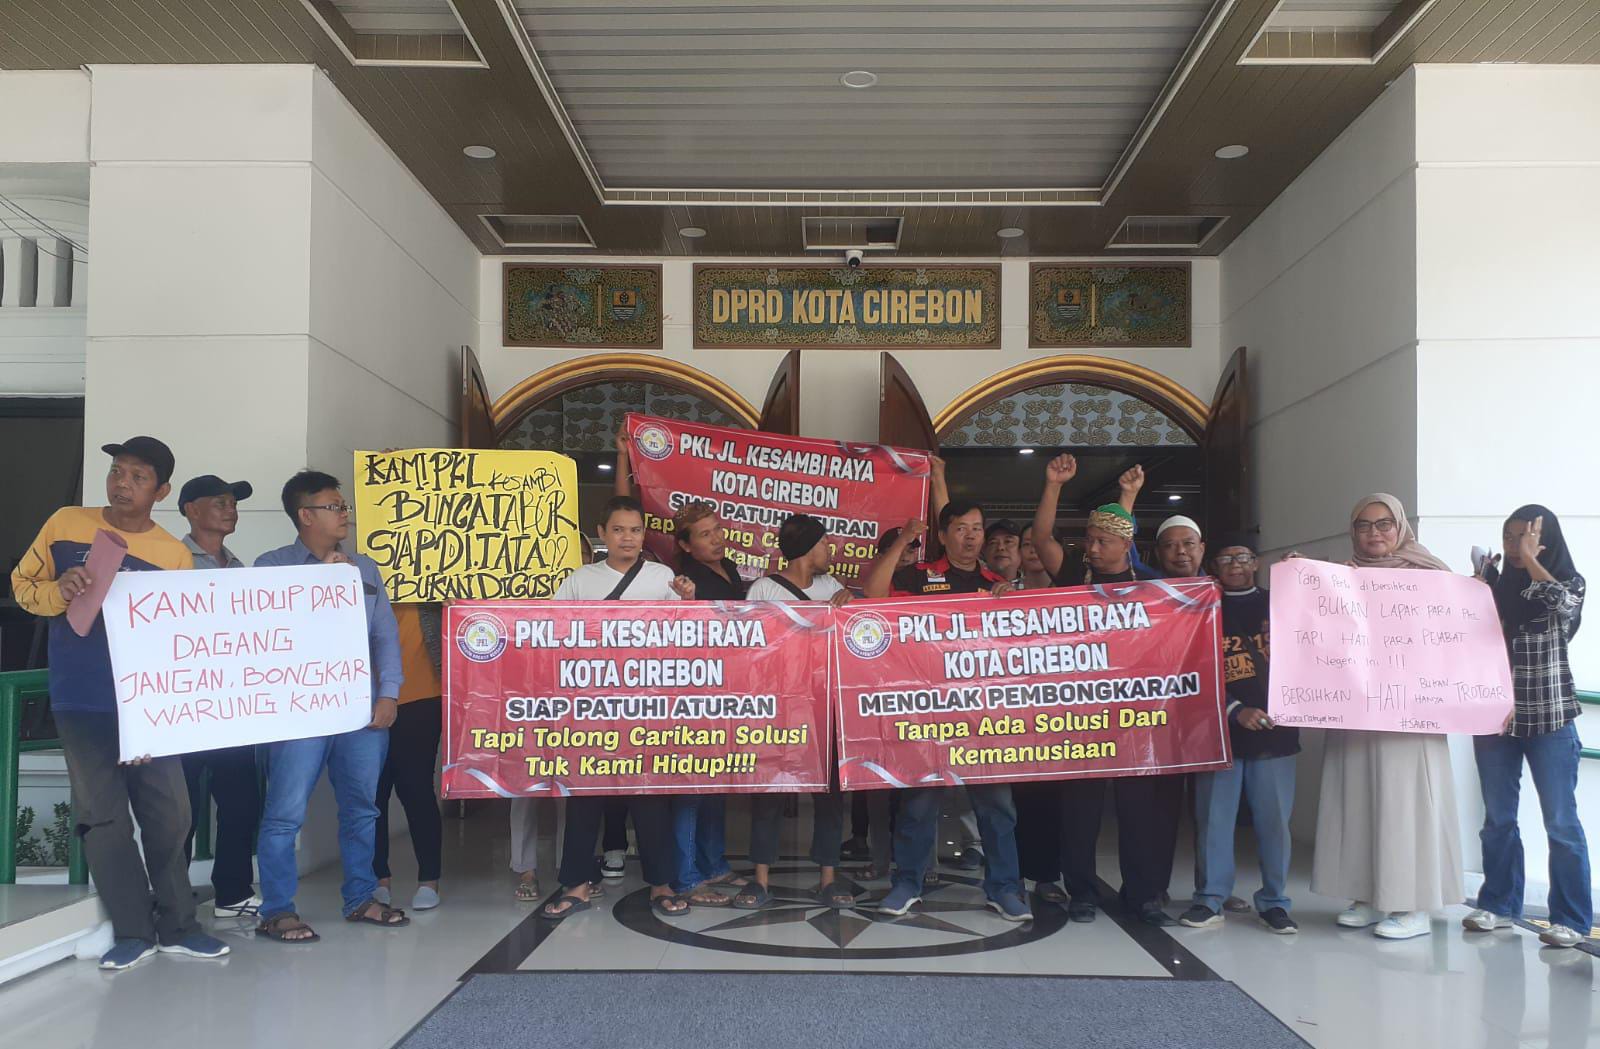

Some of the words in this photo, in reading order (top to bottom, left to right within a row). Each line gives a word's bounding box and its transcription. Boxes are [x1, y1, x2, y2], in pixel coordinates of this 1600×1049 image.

[712, 289, 783, 324] DPRD
[792, 289, 856, 324] KOTA
[863, 289, 982, 324] CIREBON
[428, 450, 485, 491] PKL
[679, 433, 714, 460] PKL
[716, 440, 742, 465] JL.
[746, 444, 826, 476] KESAMBI
[830, 455, 874, 483] RAYA
[711, 470, 757, 498] KOTA
[760, 478, 839, 510] CIREBON
[644, 513, 675, 534] Tap
[808, 515, 878, 539] URAN
[384, 573, 475, 600] BUKAN
[1294, 566, 1320, 590] Yang
[231, 584, 304, 615] HIDUP
[1318, 595, 1368, 618] BUKAN
[1380, 603, 1419, 620] LAPAK
[1427, 604, 1451, 619] PARA
[515, 620, 560, 648] PKL
[563, 620, 597, 648] JL.
[602, 620, 704, 648] KESAMBI
[708, 620, 766, 648] RAYA
[898, 615, 944, 643] PKL
[946, 614, 978, 641] JL.
[981, 606, 1085, 637] KESAMBI
[1087, 601, 1150, 631] RAYA
[173, 628, 293, 661] DAGANG
[1294, 630, 1324, 646] TAPI
[1342, 631, 1370, 647] HATI
[1383, 635, 1413, 648] PARA
[1422, 628, 1468, 646] PEJABAT
[243, 658, 368, 687] BONGKAR
[560, 659, 620, 688] KOTA
[624, 659, 723, 687] CIREBON
[944, 648, 1010, 679] KOTA
[1011, 643, 1109, 676] CIREBON
[1316, 655, 1356, 669] Negeri
[859, 686, 983, 716] MENOLAK
[987, 673, 1199, 709] PEMBONGKARAN
[1281, 685, 1352, 706] BERSIHKAN
[1366, 680, 1406, 713] HATI
[1453, 681, 1508, 704] TROTOAR
[144, 693, 277, 726] WARUNG
[507, 698, 570, 720] SIAP
[574, 697, 667, 719] PATUHI
[672, 696, 776, 719] ATURAN
[471, 727, 525, 752] Tapi
[534, 727, 620, 751] Tolong
[630, 725, 726, 746] Carikan
[735, 724, 808, 745] Solusi
[895, 719, 970, 742] Tanpa
[978, 716, 1026, 737] Ada
[1035, 709, 1110, 734] Solusi
[1119, 707, 1167, 728] Dan
[525, 755, 570, 776] Tuk
[579, 755, 643, 776] Kami
[653, 752, 757, 777] Hidup!!!!
[949, 739, 1117, 766] Kemanusiaan
